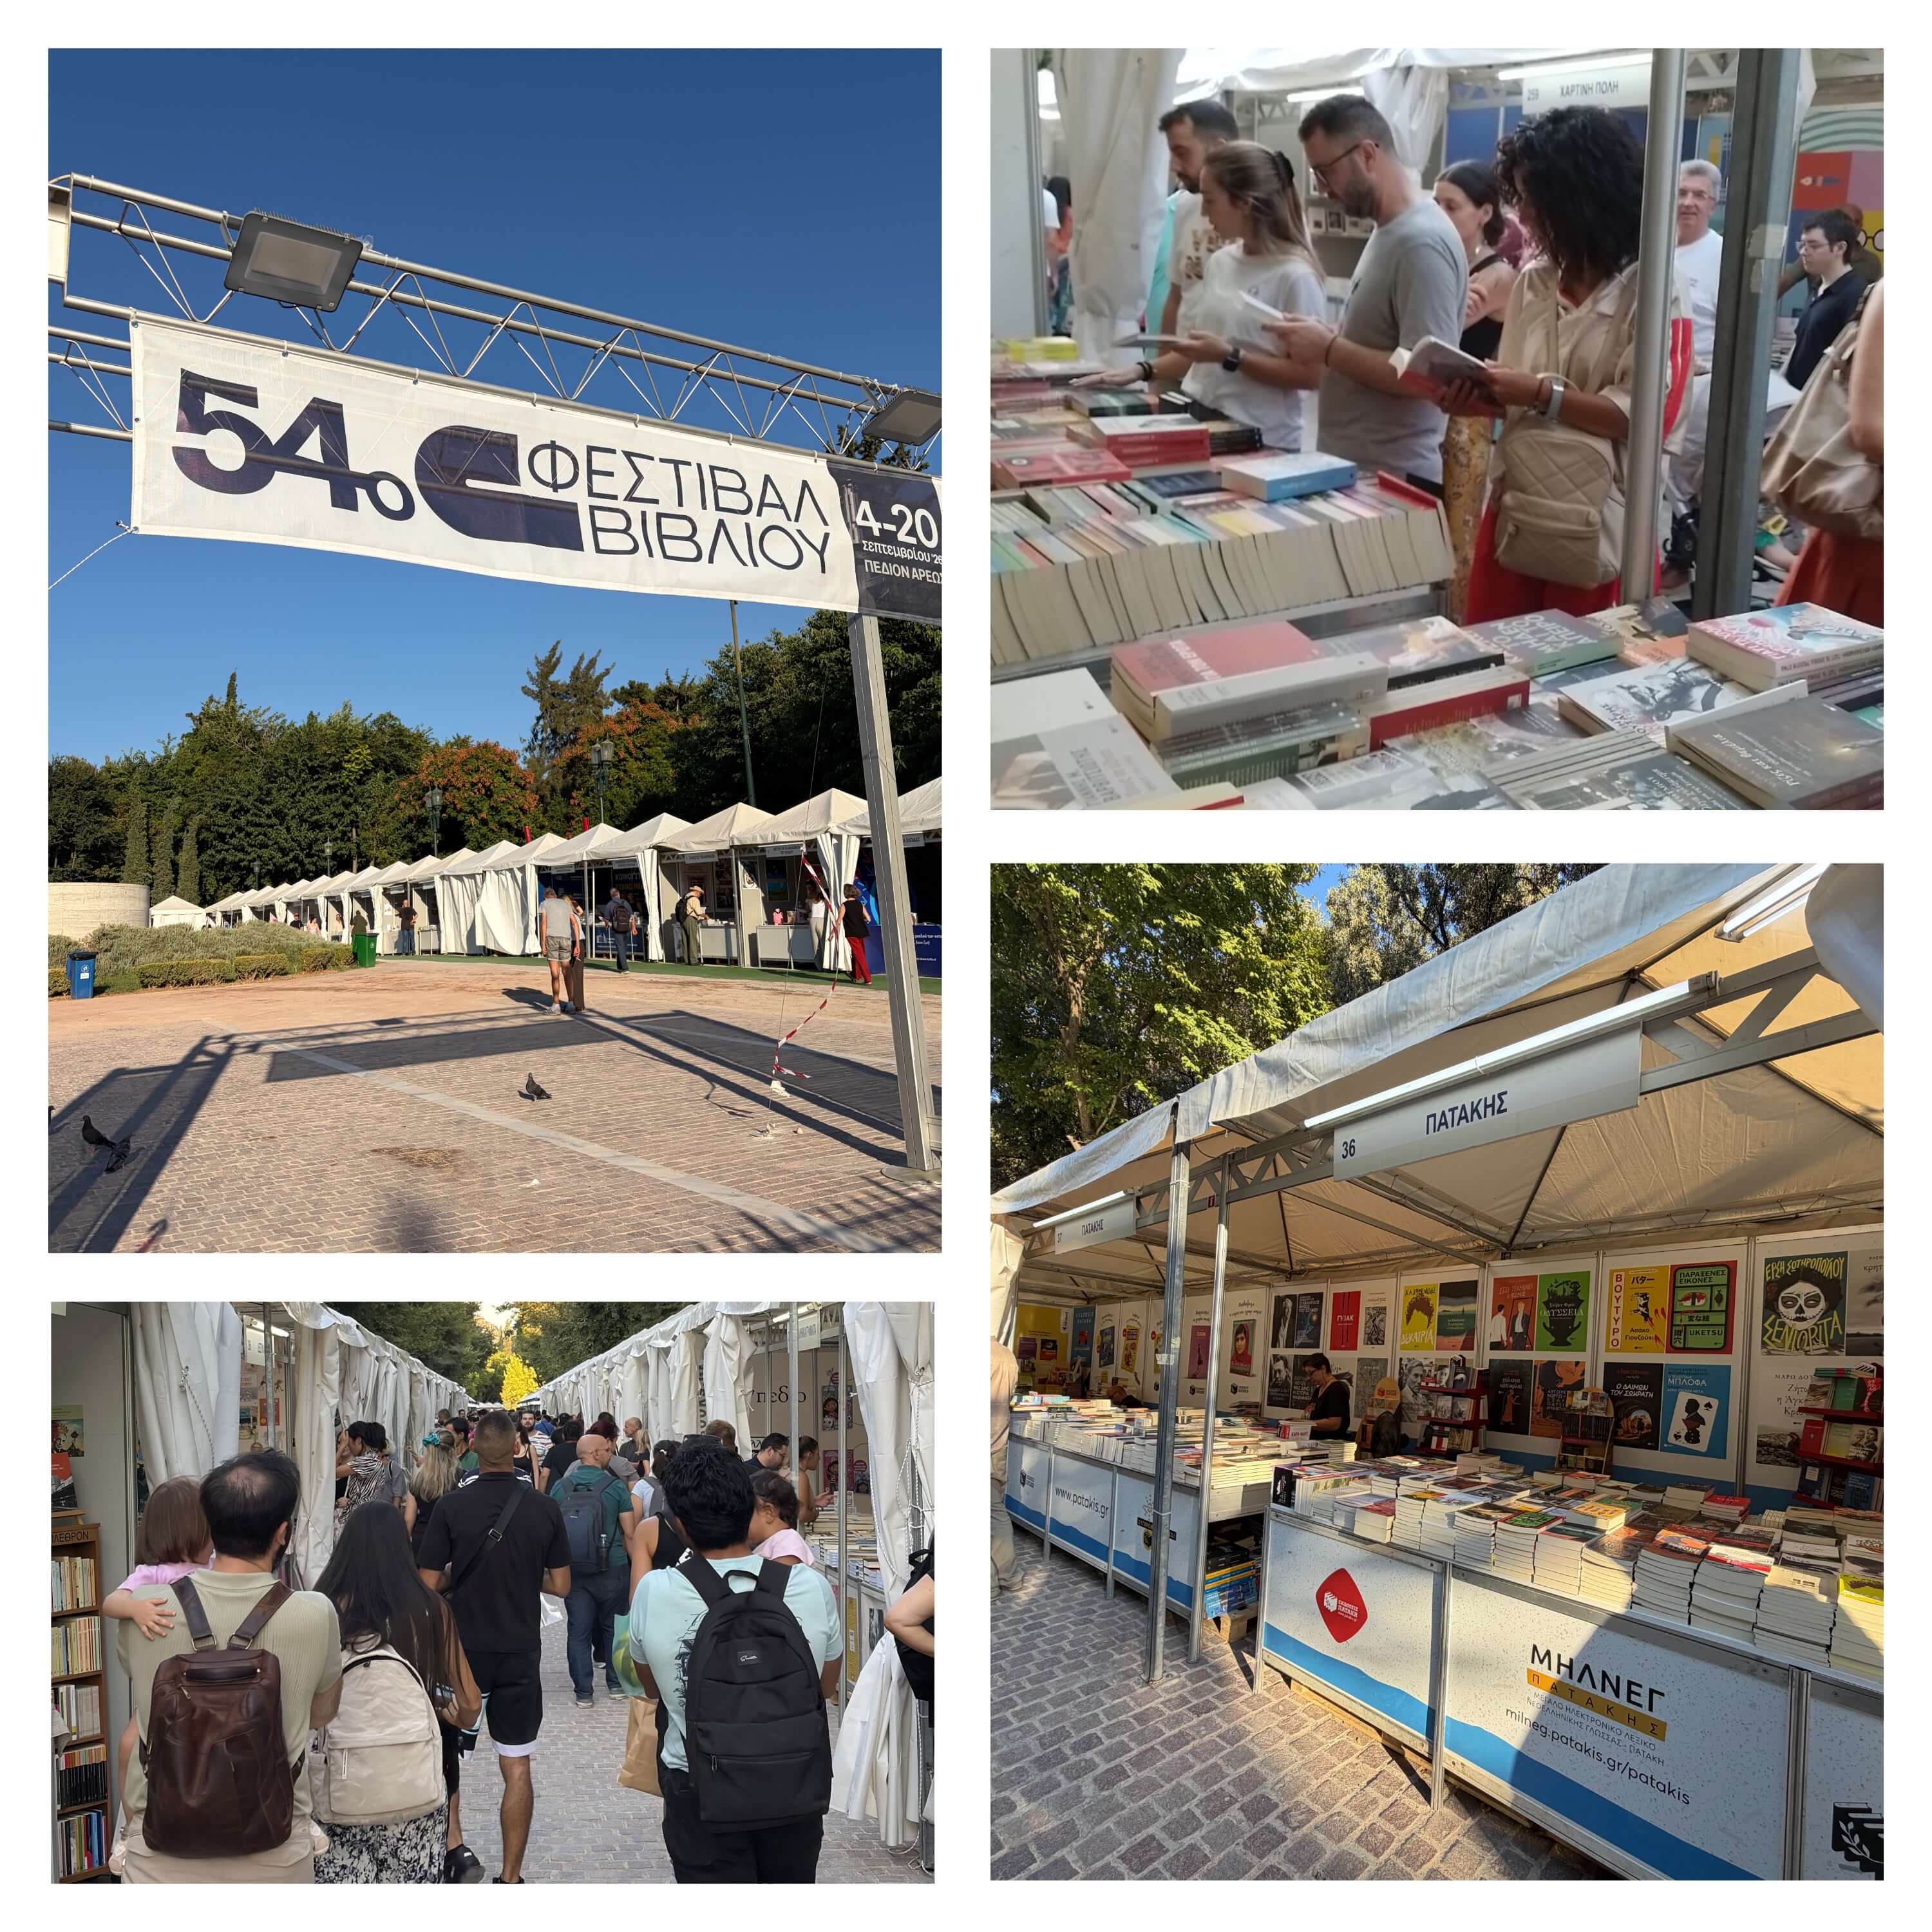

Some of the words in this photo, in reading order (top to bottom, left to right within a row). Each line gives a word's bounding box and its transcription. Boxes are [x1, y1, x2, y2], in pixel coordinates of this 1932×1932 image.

[1560, 82, 1593, 97] ΧΑΡΤΙΝΗ
[1595, 80, 1618, 93] ΠΟΛΗ
[527, 439, 829, 527] ΦΕΣΤΙΒΑΛ
[589, 504, 830, 574] ΒΙΒΛΙΟΥ
[855, 500, 938, 549] 4-20
[862, 540, 931, 562] Σεπτεμβρίου
[864, 559, 909, 578] ΠΕΔΙΟΝ
[1341, 1138, 1356, 1159] 36
[1426, 1090, 1508, 1135] ΠΑΤΑΚΗΣ
[1057, 1231, 1063, 1244] 37
[1081, 1218, 1104, 1237] ΠΑΤΑΚΗΣ
[1631, 1276, 1654, 1285] バター
[1680, 1269, 1726, 1278] ΠΑΡΑΞΕΝΕΣ
[1765, 1260, 1785, 1282] ΕΡΣΗ
[1611, 1274, 1622, 1347] ΒΟΥΤΥΡΟ
[757, 1385, 806, 1403] πεδο
[1055, 1486, 1109, 1519] www.patakis.gr
[1338, 1605, 1358, 1618] ΠΑΤΑΚΗ
[1531, 1643, 1665, 1712] ΜΗΛΝΕΓ
[1532, 1673, 1659, 1736] ΠΑΤΑΚΗΣ
[1534, 1691, 1564, 1710] ΜΕΓΑΛΟ
[1566, 1706, 1622, 1736] ΗΛΕΚΤΡΟΝΙΚΟ
[1624, 1730, 1656, 1751] ΛΕΞΙΚΟ
[1527, 1696, 1584, 1730] ΝΕΟΕΛΛΗΝΙΚΗΣ
[1586, 1725, 1622, 1747] ΓΛΩΣΣΑΣ
[1629, 1744, 1665, 1767] ΠΑΤΑΚΗ
[1506, 1707, 1690, 1806] milneg.patakis.gr/patakis
